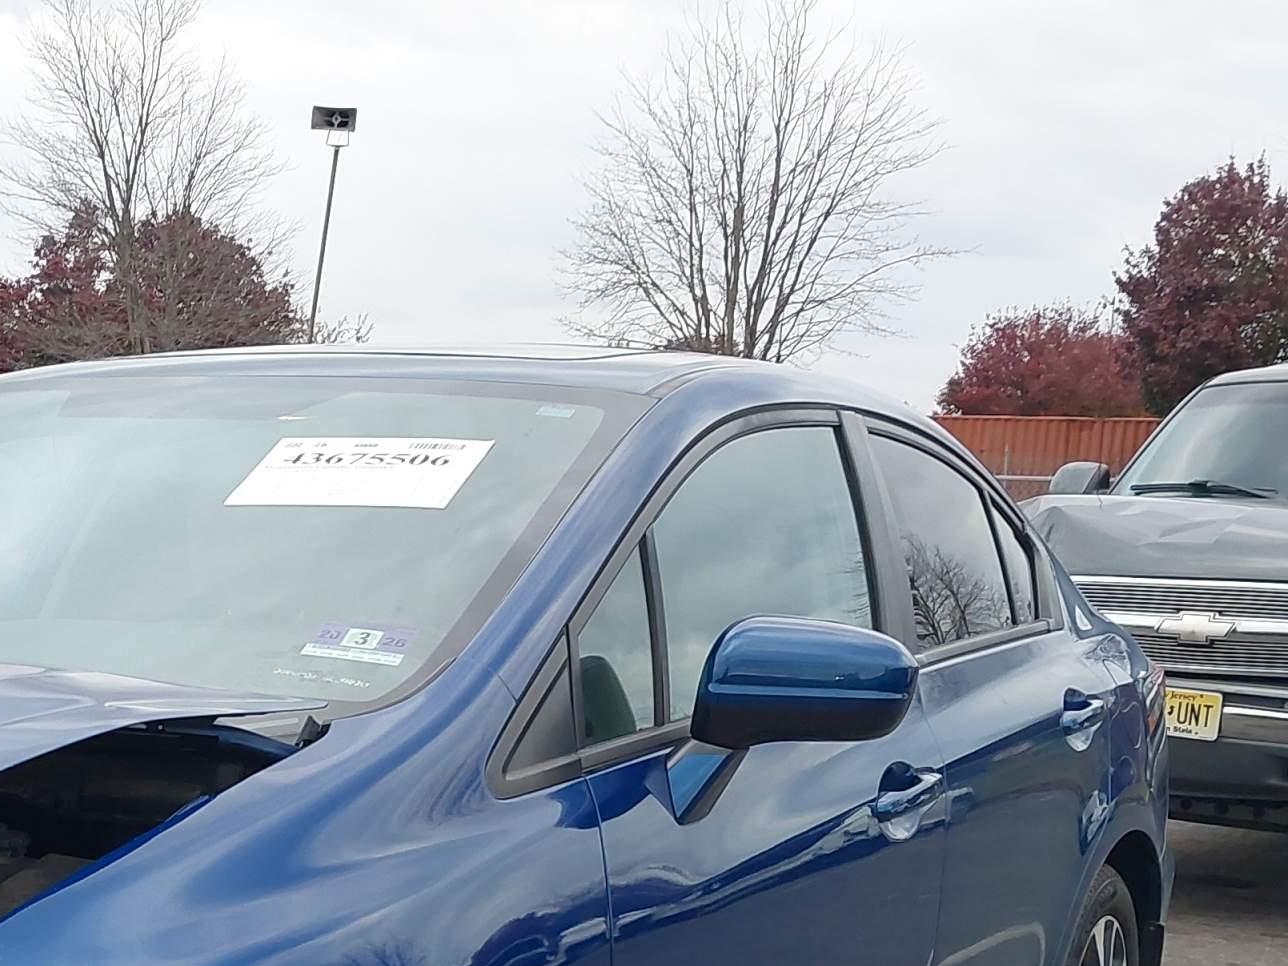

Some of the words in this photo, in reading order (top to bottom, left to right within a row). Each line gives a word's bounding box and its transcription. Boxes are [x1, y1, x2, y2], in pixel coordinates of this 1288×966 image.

[282, 452, 451, 466] 43675506
[354, 631, 371, 646] 3
[382, 636, 408, 648] 26
[1169, 691, 1198, 701] Jersey
[1177, 702, 1213, 727] UNT
[1173, 726, 1192, 734] State
